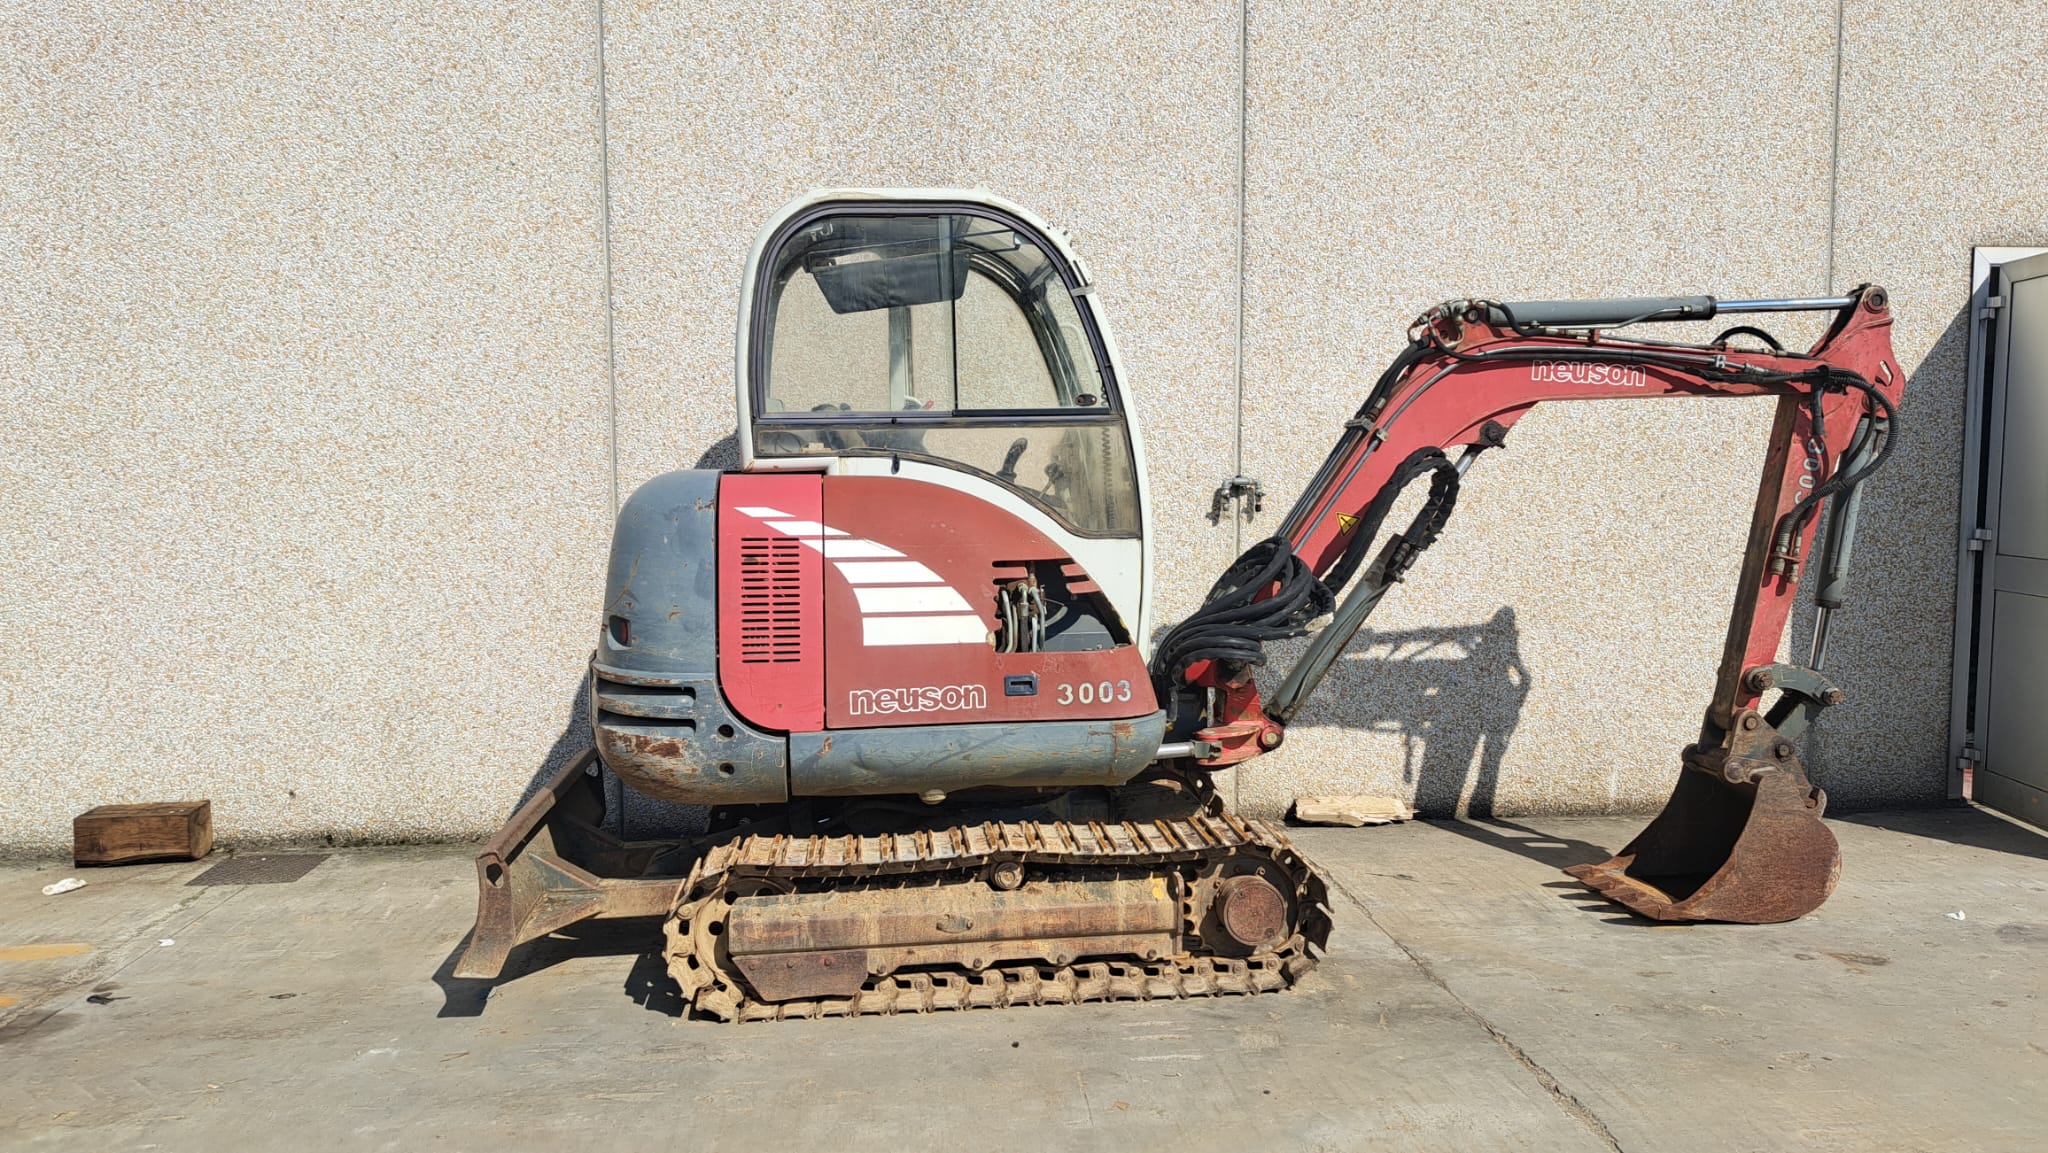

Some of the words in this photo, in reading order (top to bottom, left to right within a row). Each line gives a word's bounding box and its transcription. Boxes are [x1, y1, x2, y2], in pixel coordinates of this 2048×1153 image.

[1531, 360, 1646, 387] neuson
[850, 684, 987, 715] neuson
[1057, 680, 1132, 705] 3003
